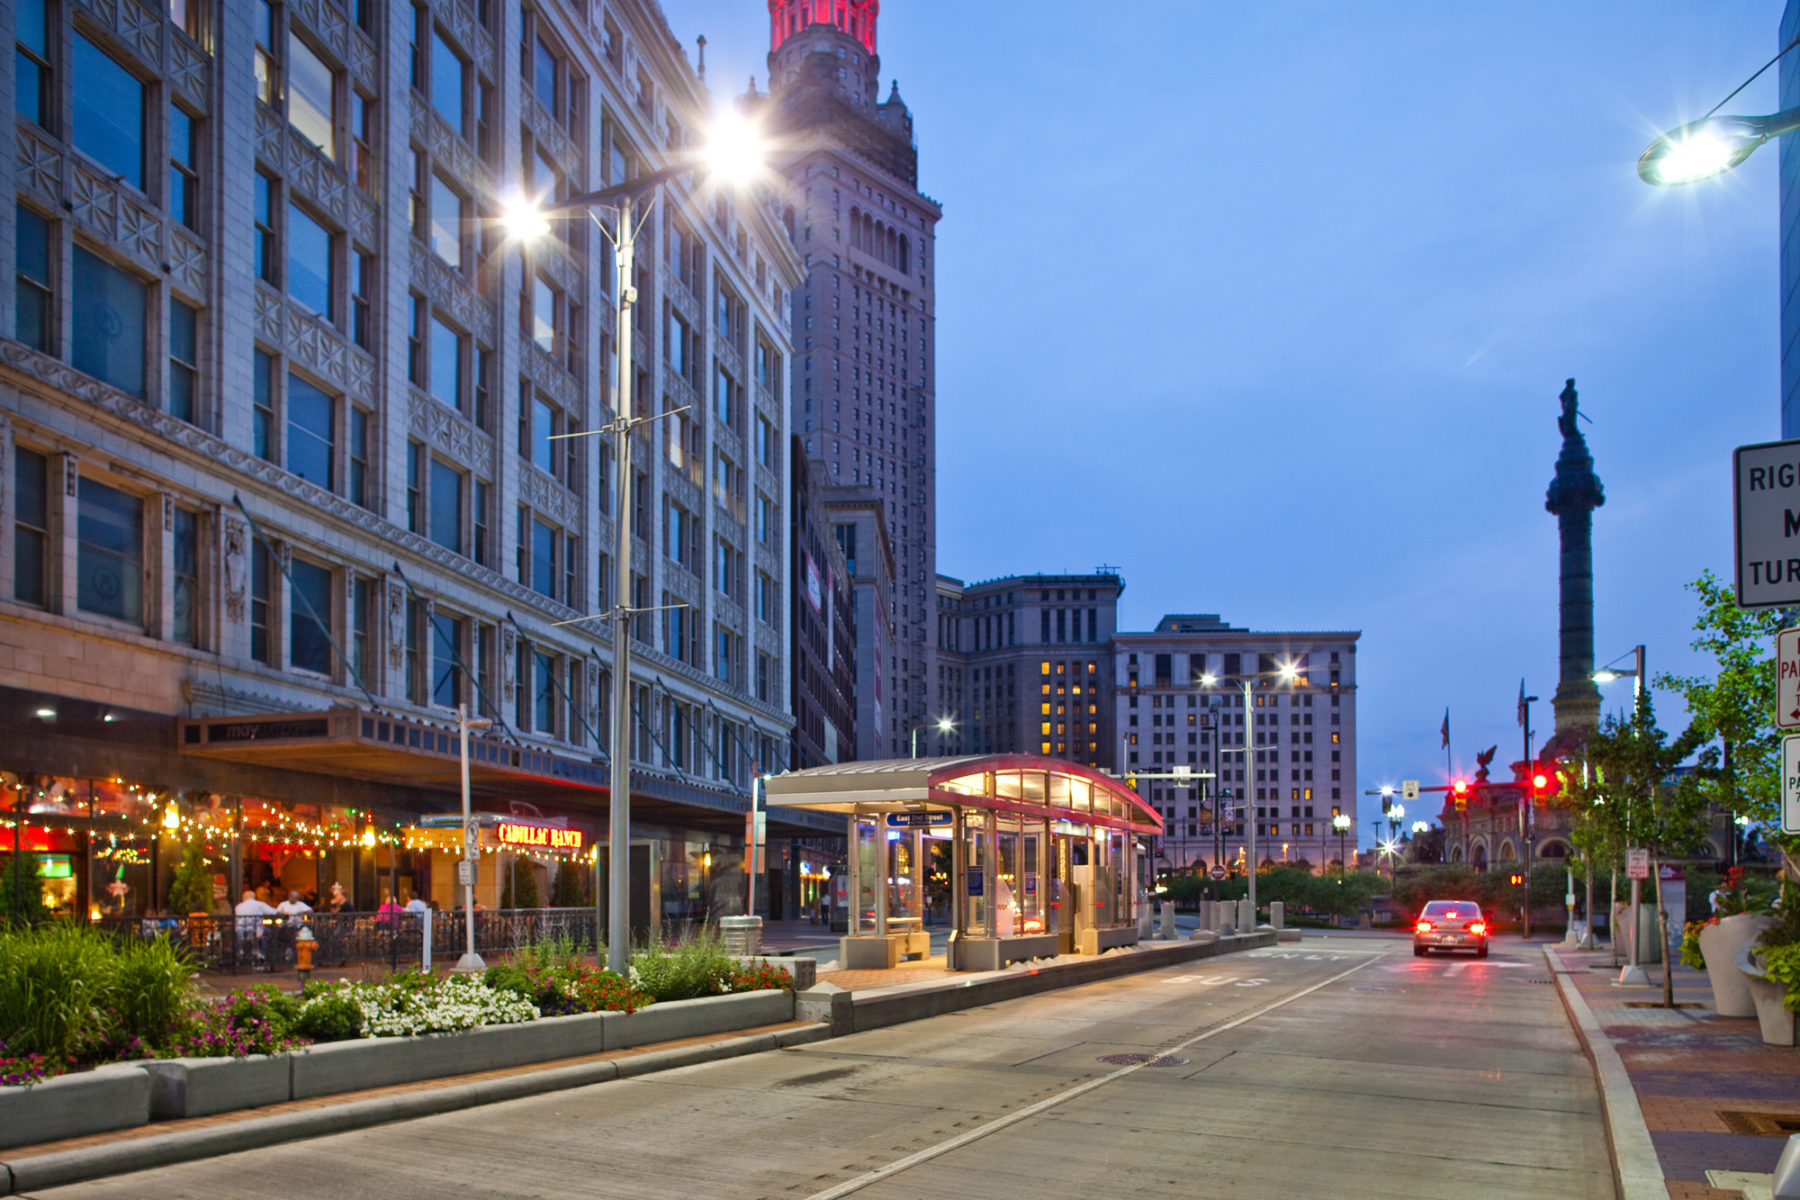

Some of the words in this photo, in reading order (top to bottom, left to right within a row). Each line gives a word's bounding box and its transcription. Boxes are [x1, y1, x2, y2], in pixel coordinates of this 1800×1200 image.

[1749, 462, 1800, 491] RIG
[498, 823, 549, 846] CADILLAC
[550, 828, 583, 848] RANCH
[1247, 952, 1350, 961] ONLY
[1159, 974, 1272, 988] BUS
